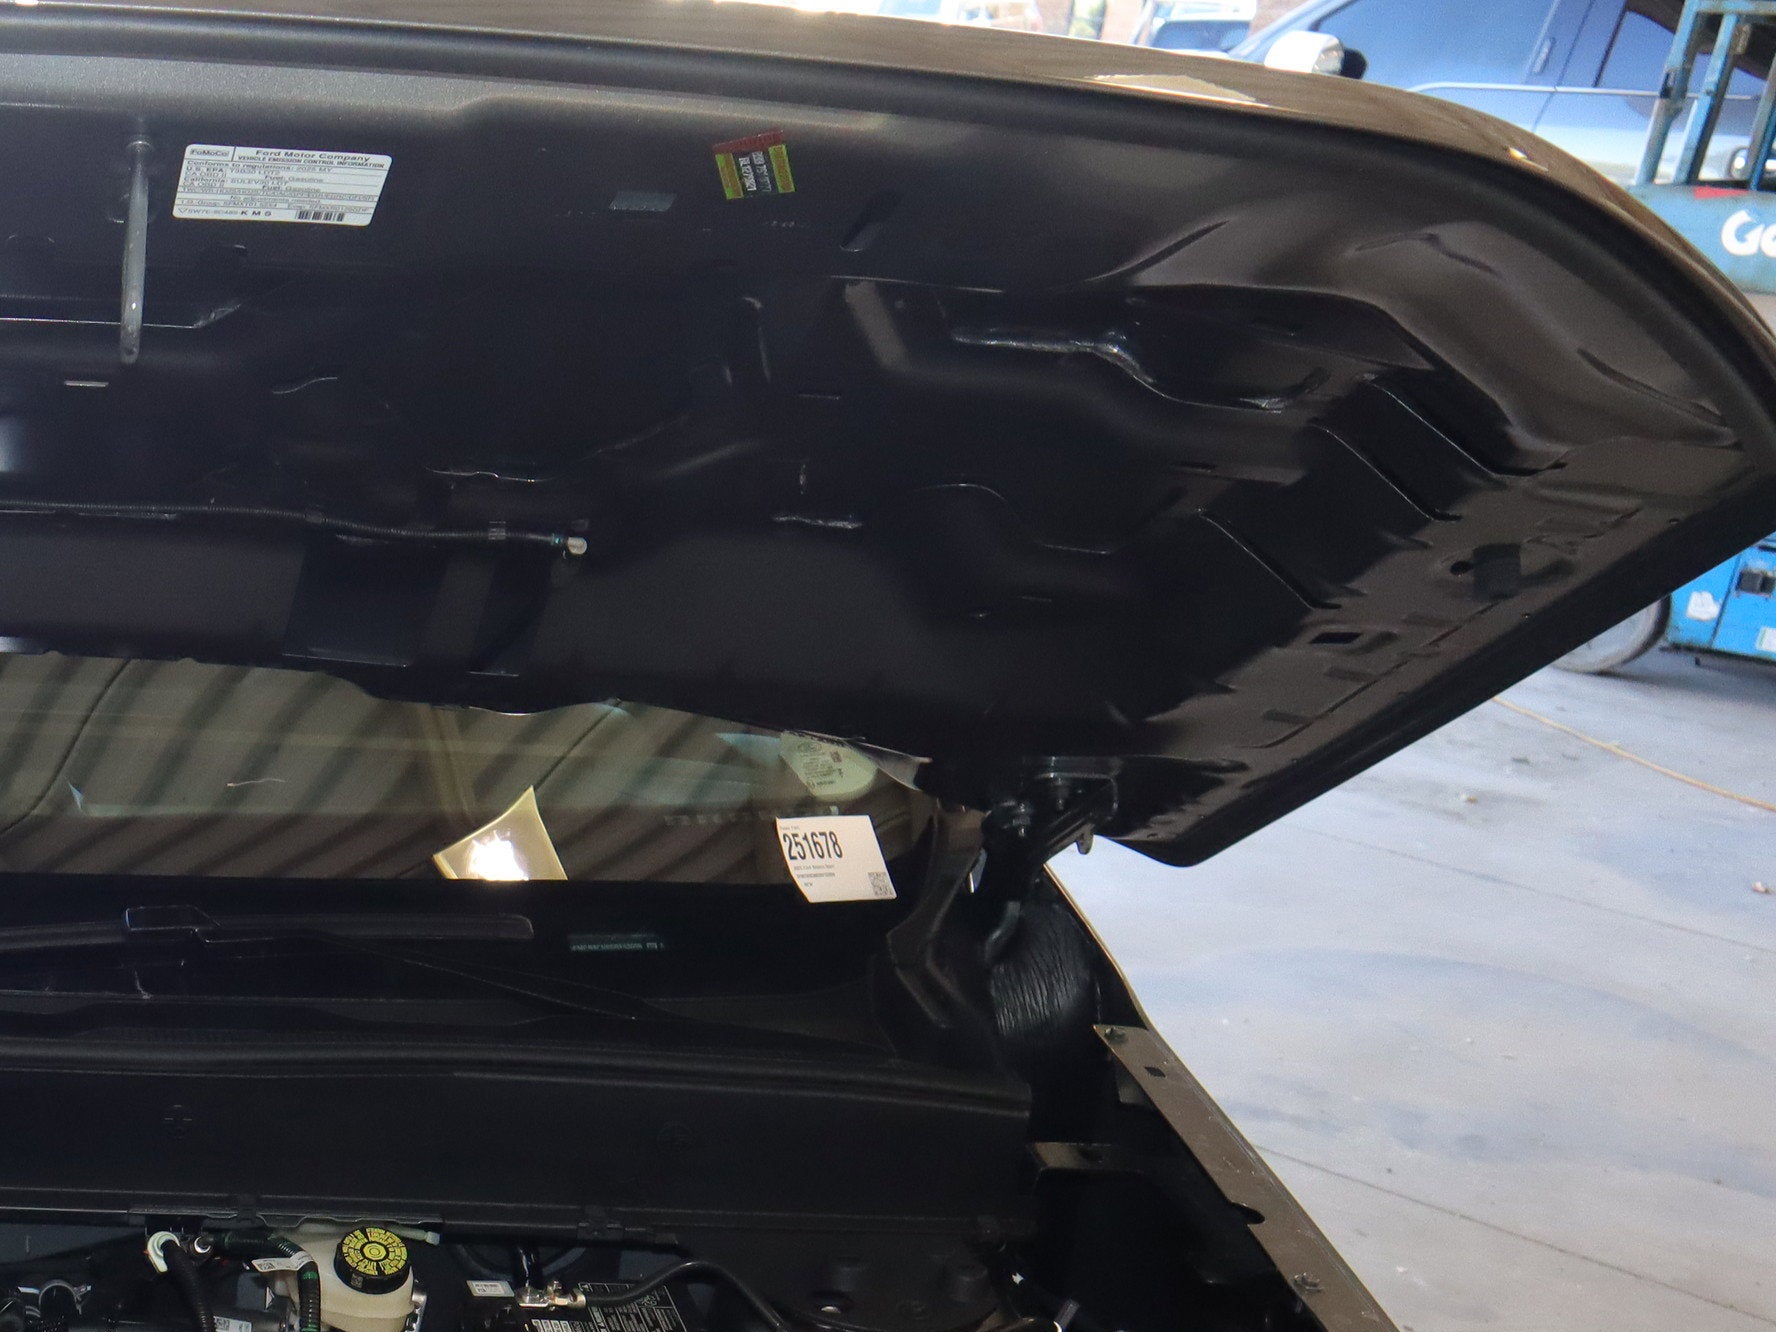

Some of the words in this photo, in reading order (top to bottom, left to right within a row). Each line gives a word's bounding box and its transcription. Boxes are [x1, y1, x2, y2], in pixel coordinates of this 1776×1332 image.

[191, 149, 229, 157] FoMoCo
[320, 153, 371, 162] Company
[184, 176, 229, 184] California:
[241, 196, 290, 204] adjustments
[782, 831, 843, 861] 251678
